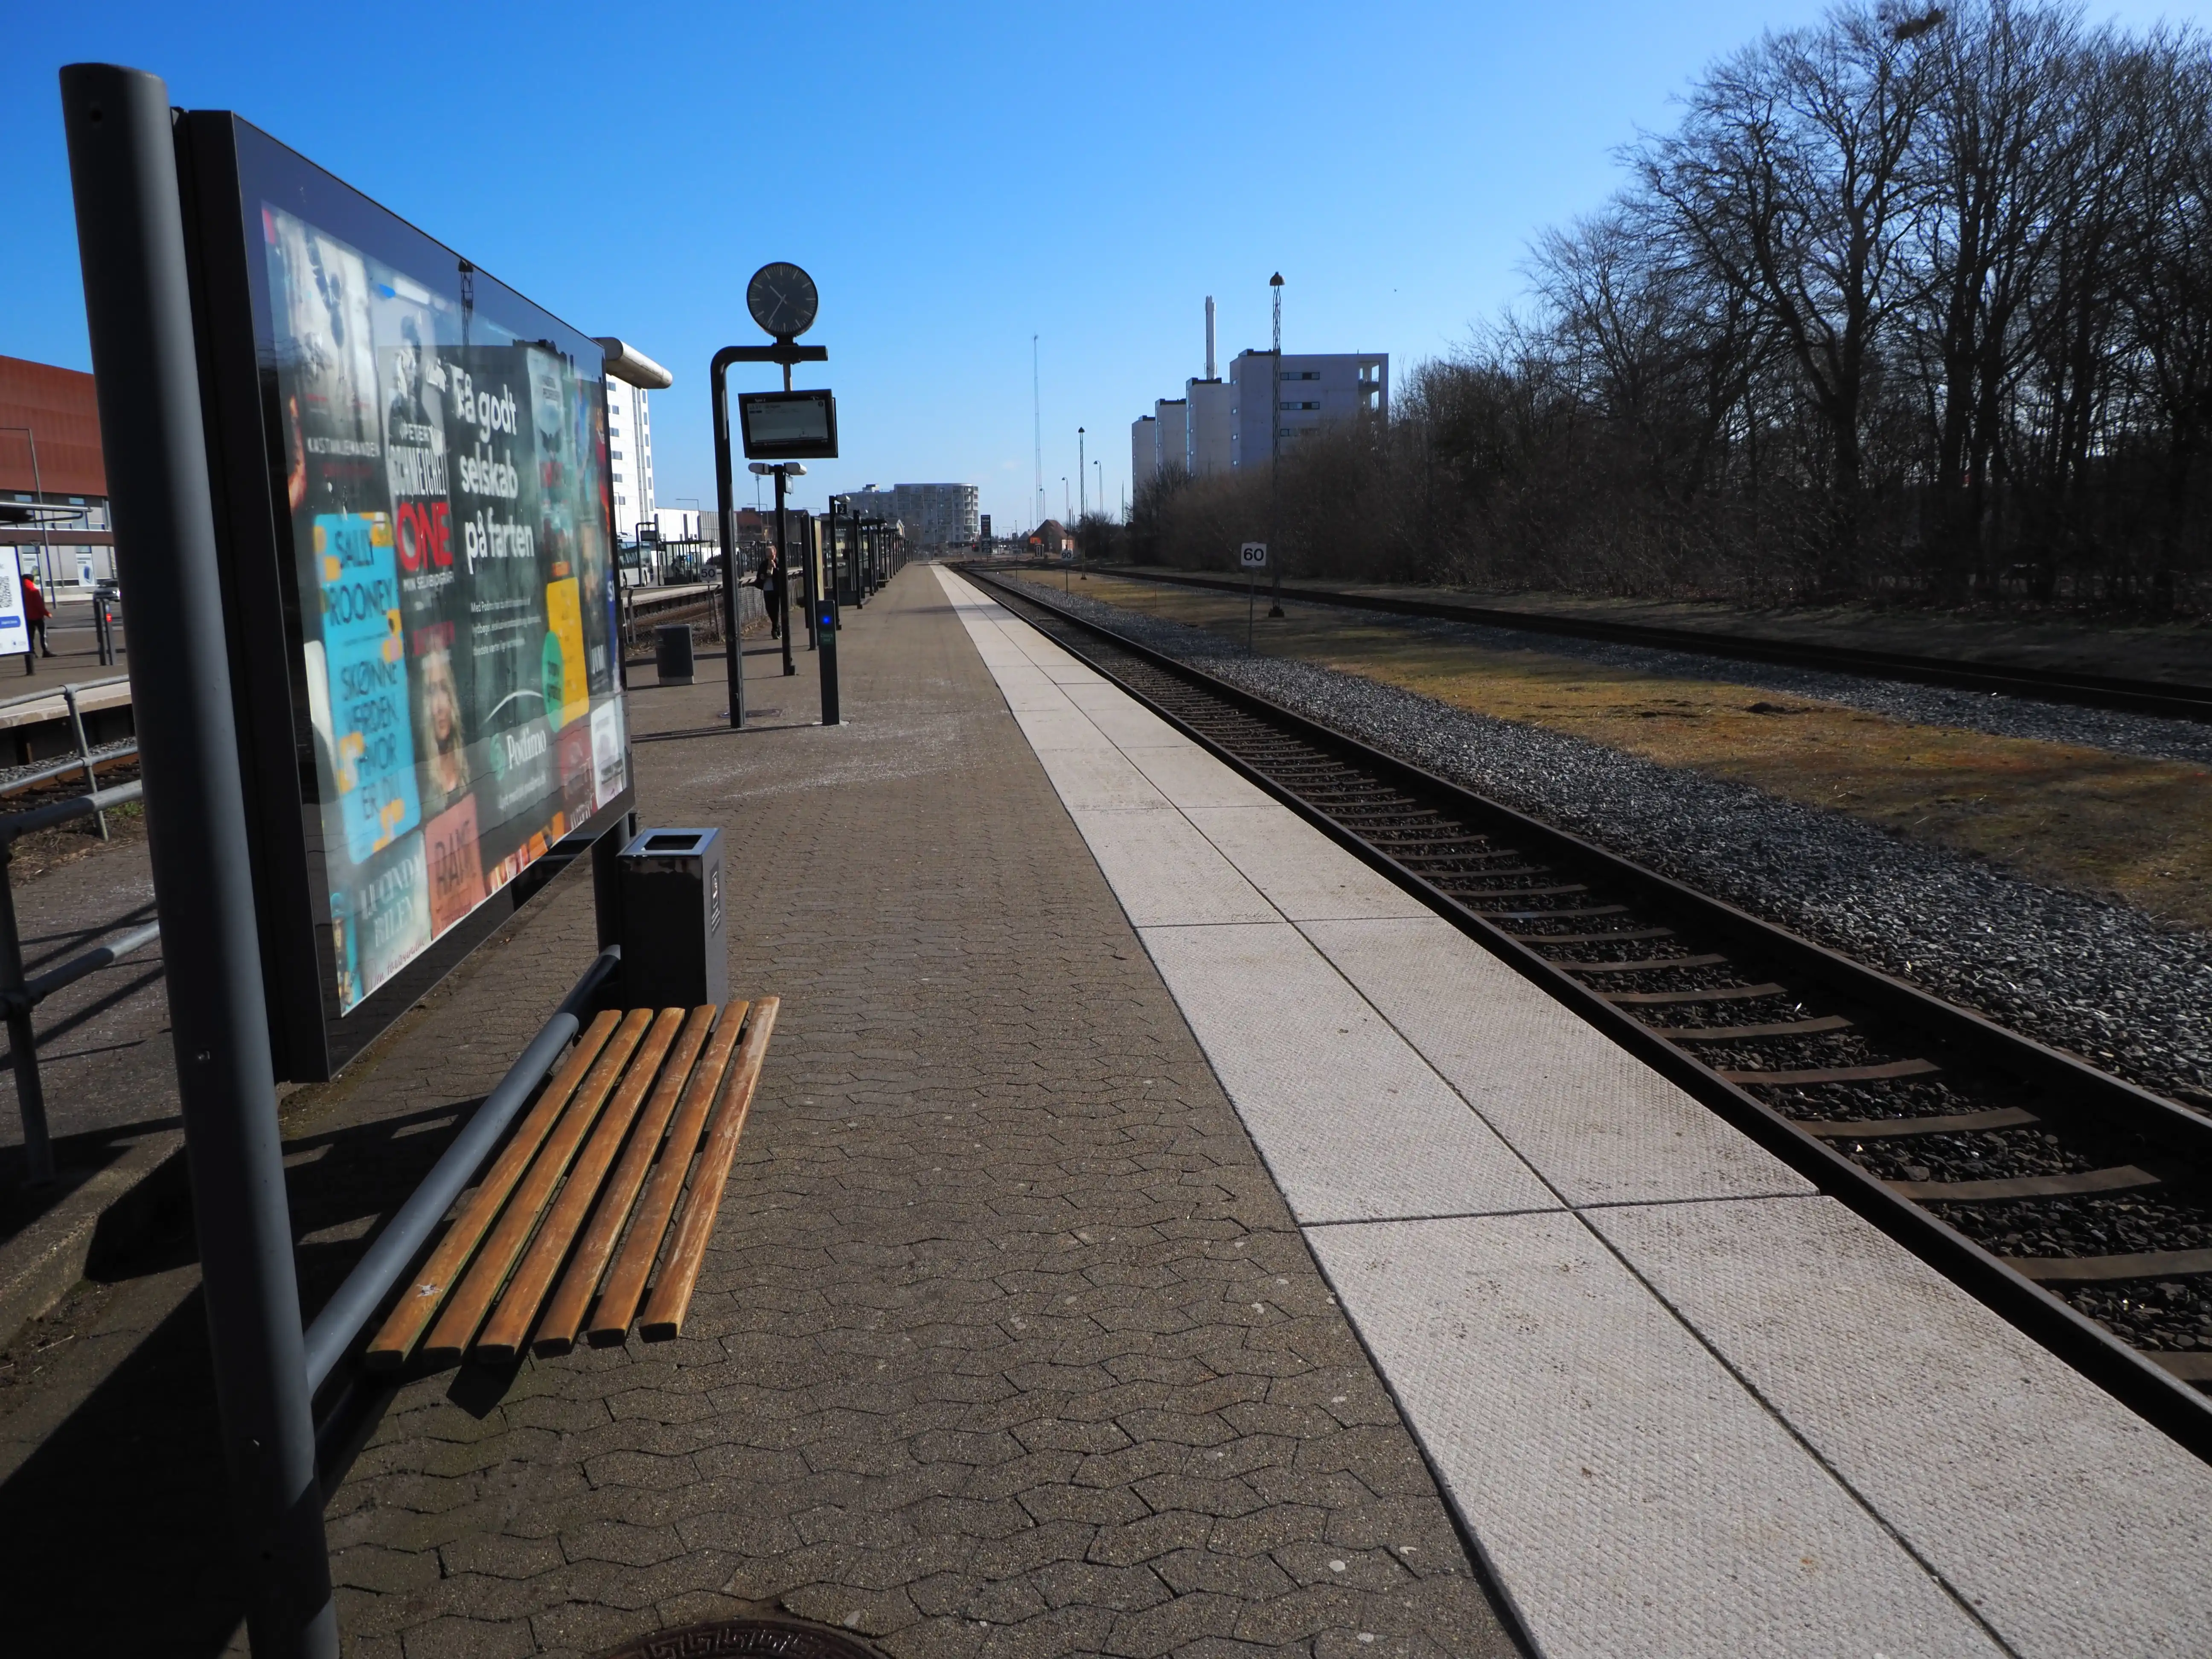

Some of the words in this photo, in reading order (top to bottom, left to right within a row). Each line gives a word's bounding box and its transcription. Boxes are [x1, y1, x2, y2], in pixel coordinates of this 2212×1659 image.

[451, 364, 476, 424] Få
[477, 384, 517, 443] godt
[459, 442, 518, 499] selskab
[335, 529, 374, 569] SALLY
[396, 502, 454, 572] ONE
[465, 510, 488, 575] på
[488, 506, 535, 557] farten
[1243, 548, 1264, 561] 60
[701, 568, 716, 578] 50
[329, 578, 394, 626] ROONEY
[341, 658, 398, 701] SKØNNE
[506, 726, 547, 770] Podimo
